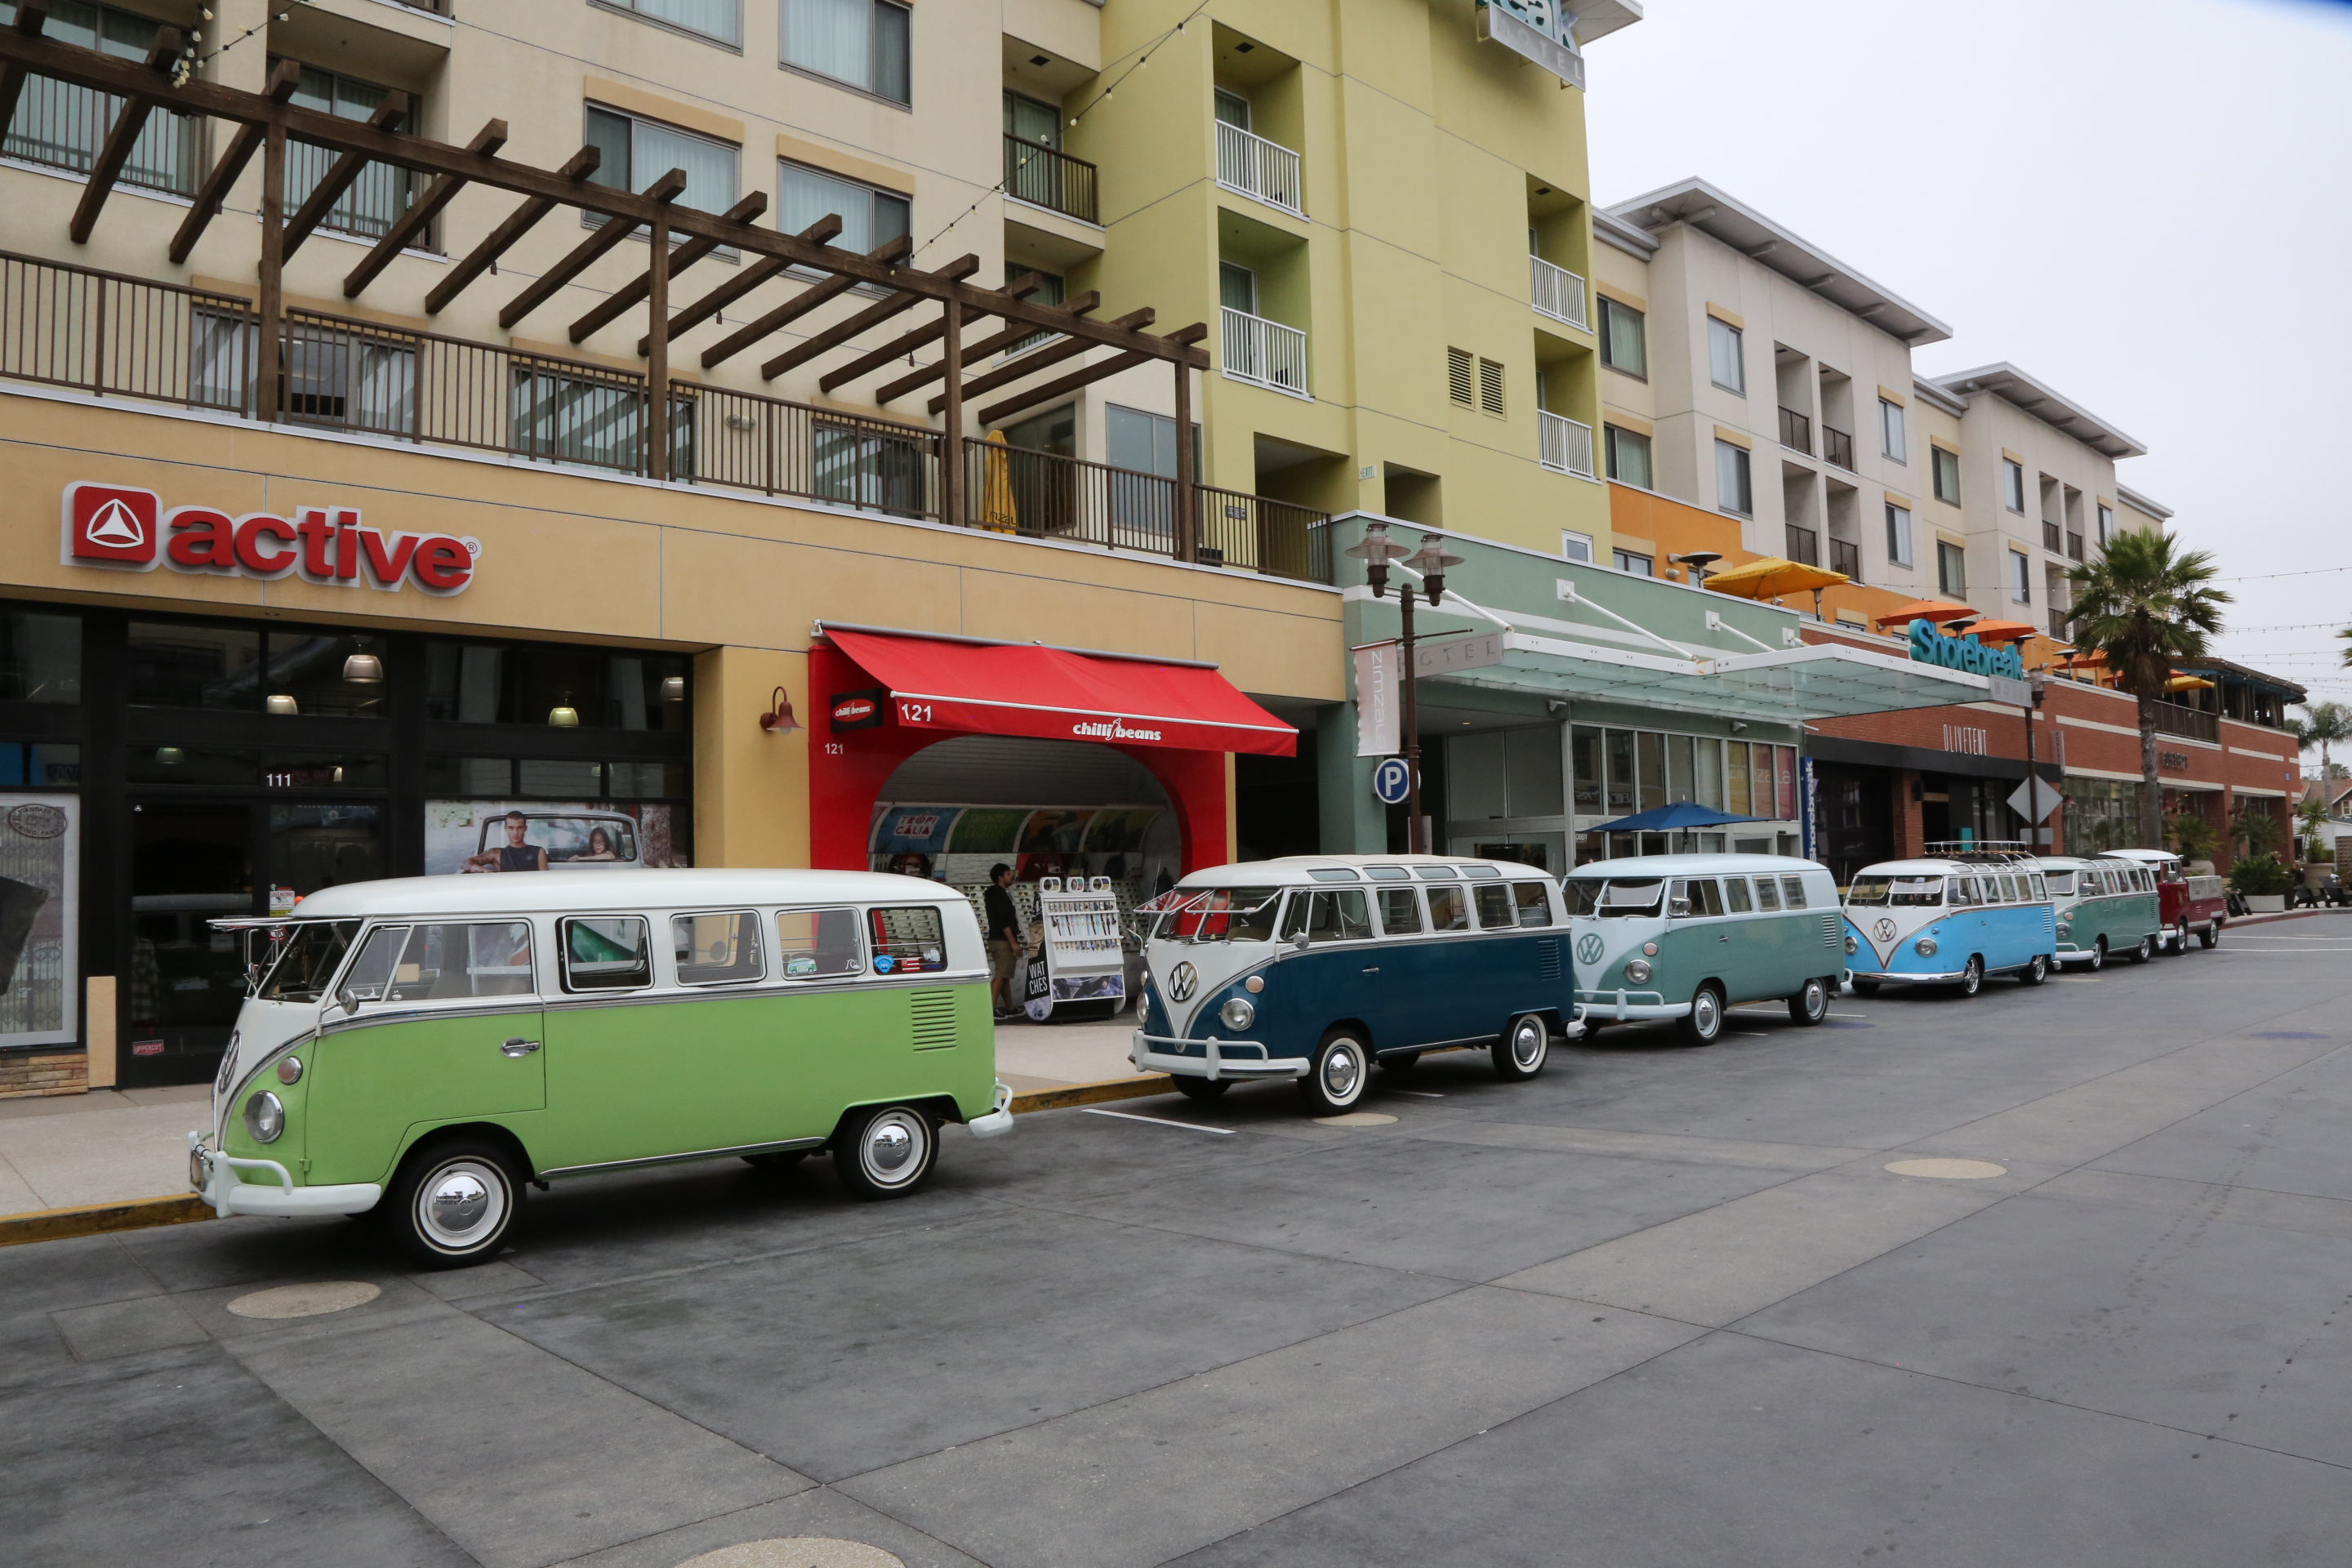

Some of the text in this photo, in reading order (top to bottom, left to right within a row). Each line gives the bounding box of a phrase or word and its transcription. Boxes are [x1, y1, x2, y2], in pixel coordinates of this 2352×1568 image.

[1497, 14, 1581, 80] HOTEL
[1361, 466, 1373, 478] EXIT
[167, 510, 473, 589] active
[1909, 618, 2024, 681] Shorebreak
[902, 703, 932, 722] 121
[1072, 722, 1161, 741] chilli beans
[825, 743, 844, 754] 121
[266, 773, 291, 786] 111
[1384, 766, 1402, 797] P
[1028, 960, 1045, 979] WAT
[1029, 976, 1048, 995] CHES
[134, 1044, 163, 1054] UPPERCUT
